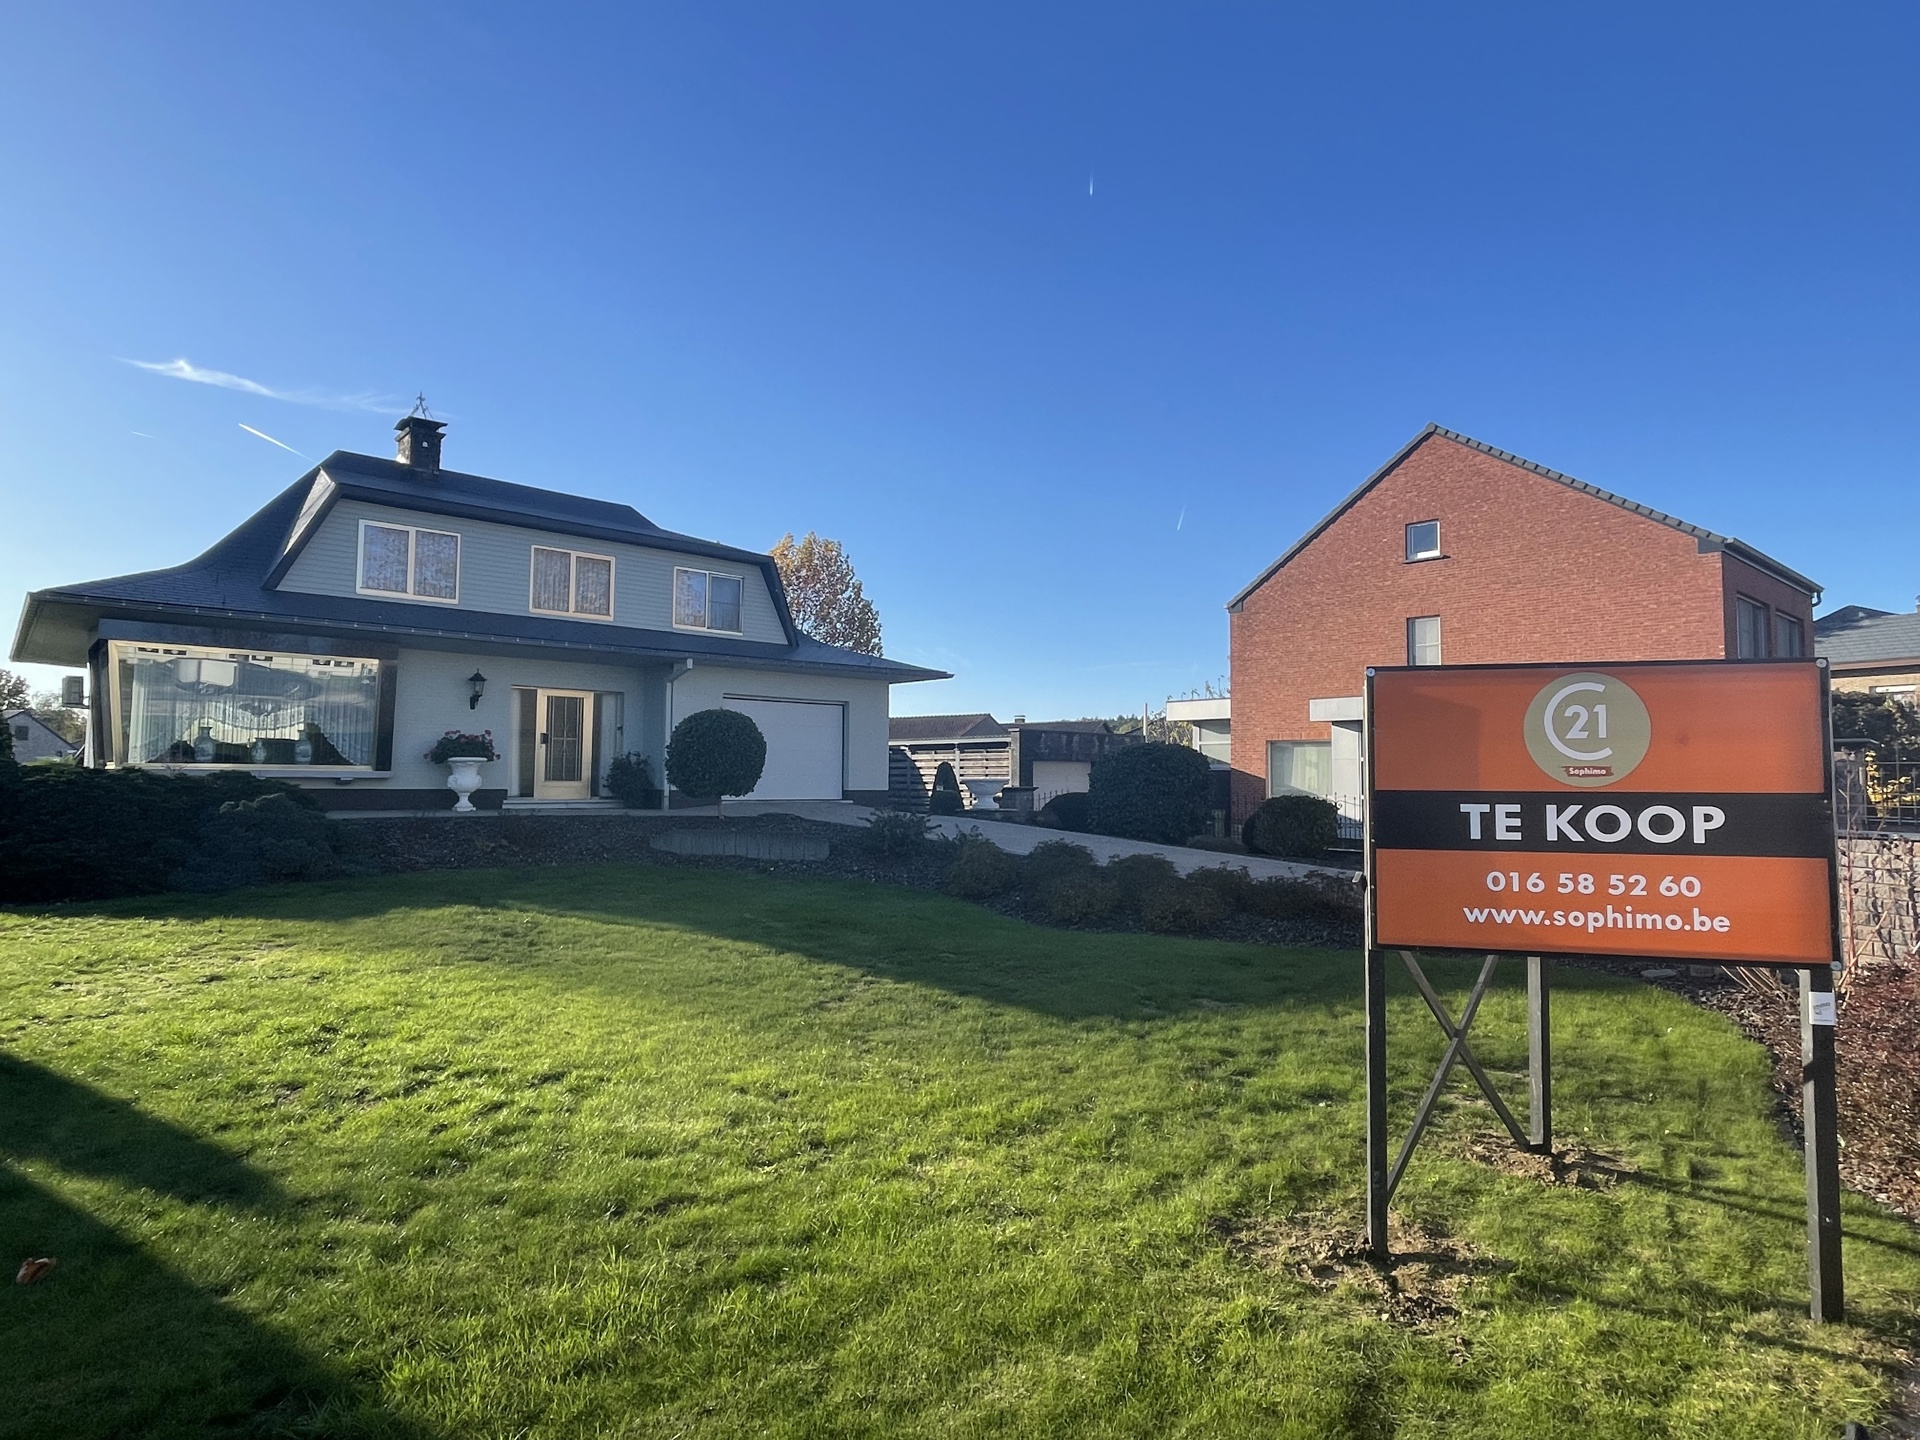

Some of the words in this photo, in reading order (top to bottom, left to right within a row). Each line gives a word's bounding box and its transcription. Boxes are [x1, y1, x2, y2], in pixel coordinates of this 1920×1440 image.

[1569, 766, 1607, 777] Sophimo
[1460, 804, 1522, 841] TE
[1546, 805, 1726, 844] KOOP
[1487, 872, 1546, 893] 016
[1558, 874, 1595, 895] 58
[1609, 875, 1648, 896] 52
[1660, 876, 1701, 898] 60
[1463, 905, 1731, 933] www.sophimo.be
